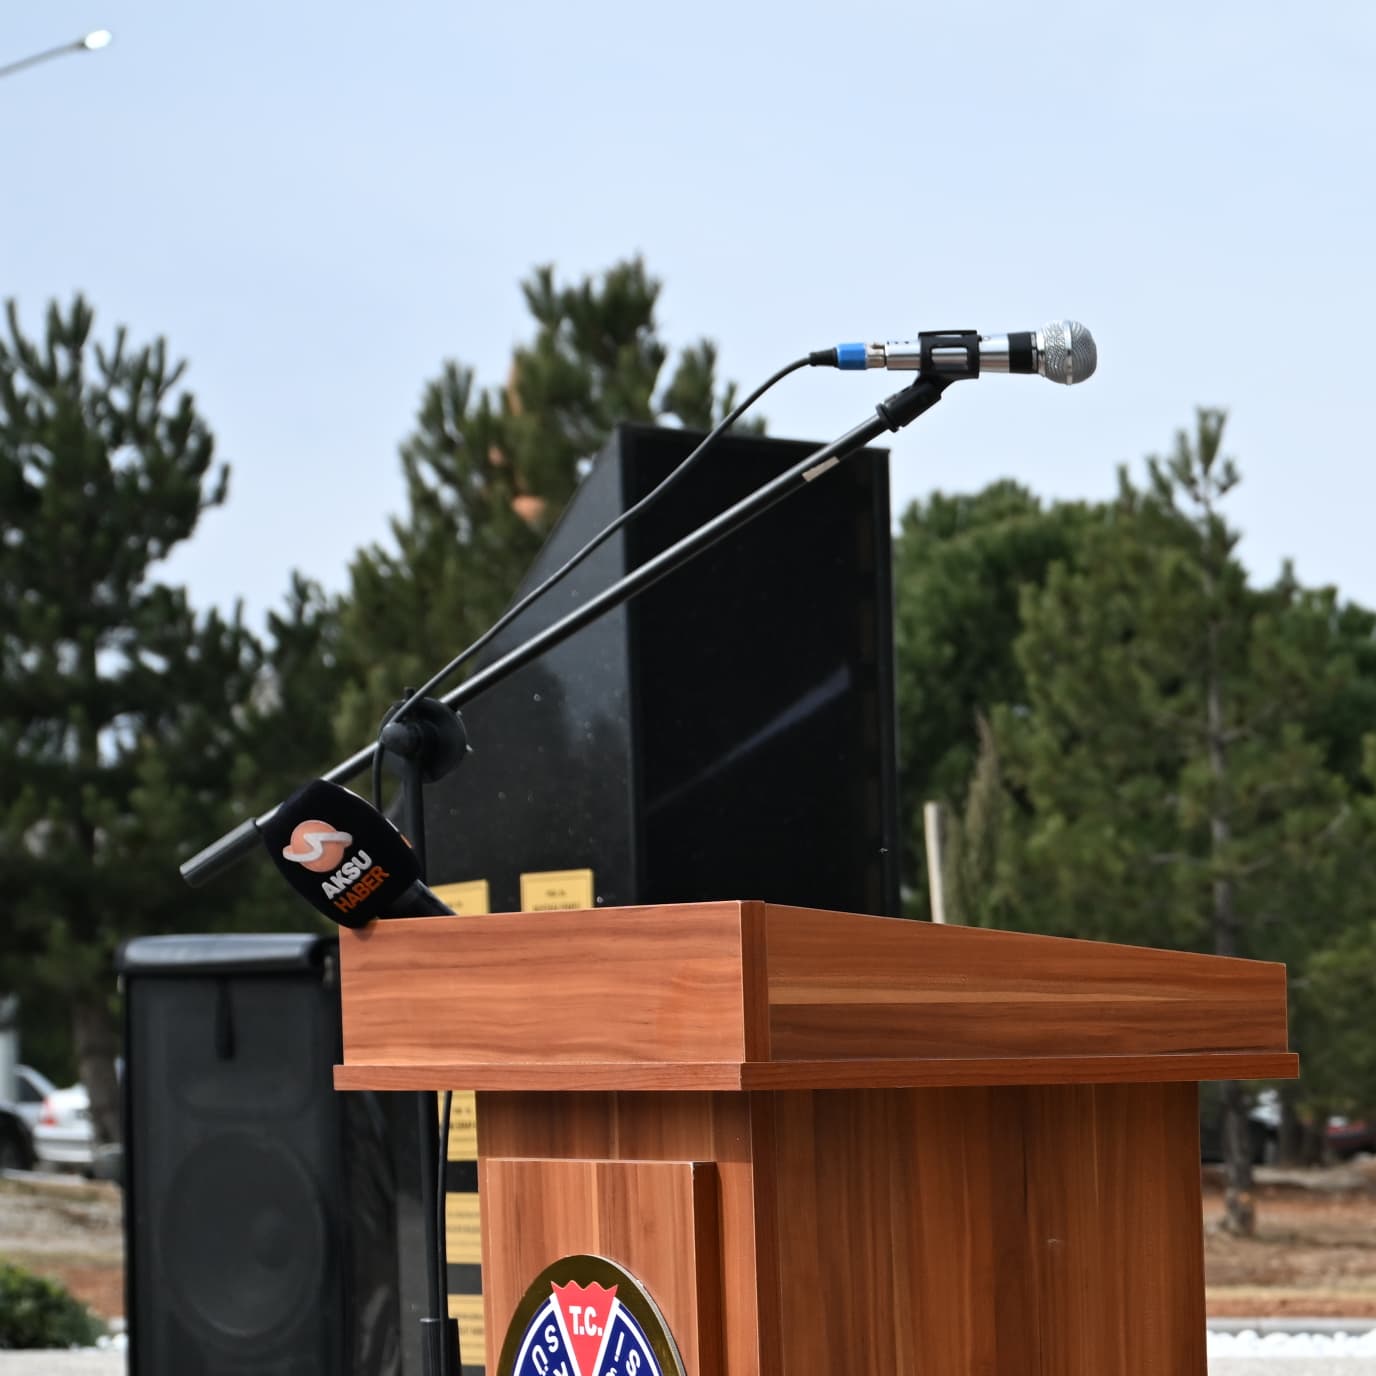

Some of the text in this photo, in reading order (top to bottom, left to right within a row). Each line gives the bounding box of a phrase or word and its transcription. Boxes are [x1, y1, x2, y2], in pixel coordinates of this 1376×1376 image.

[321, 849, 372, 899] AKSU
[334, 865, 390, 913] HABER
[568, 1305, 603, 1337] T.C.
